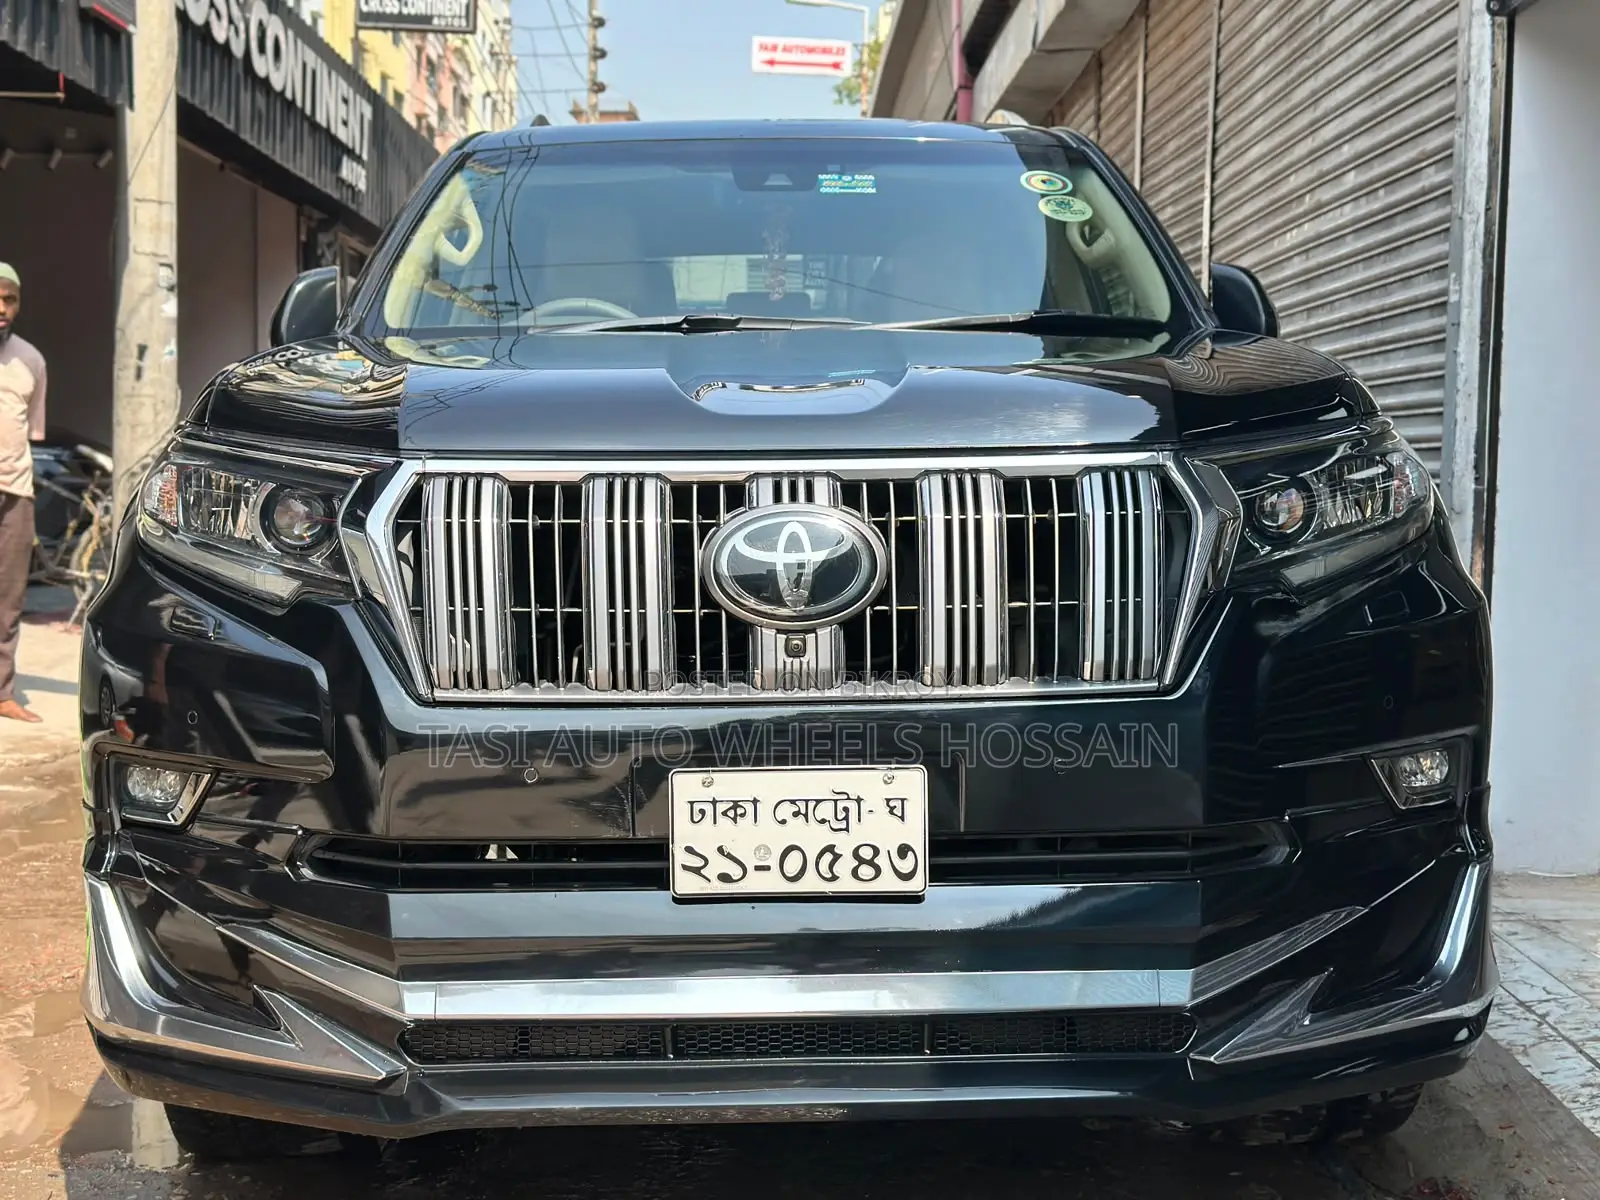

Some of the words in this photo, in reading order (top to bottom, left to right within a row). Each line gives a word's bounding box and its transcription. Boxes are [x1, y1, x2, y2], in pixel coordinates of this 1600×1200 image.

[249, 0, 373, 161] CONTINENT
[687, 796, 761, 826] ঢাকা
[680, 843, 919, 883] ২১-০৫৪৩
